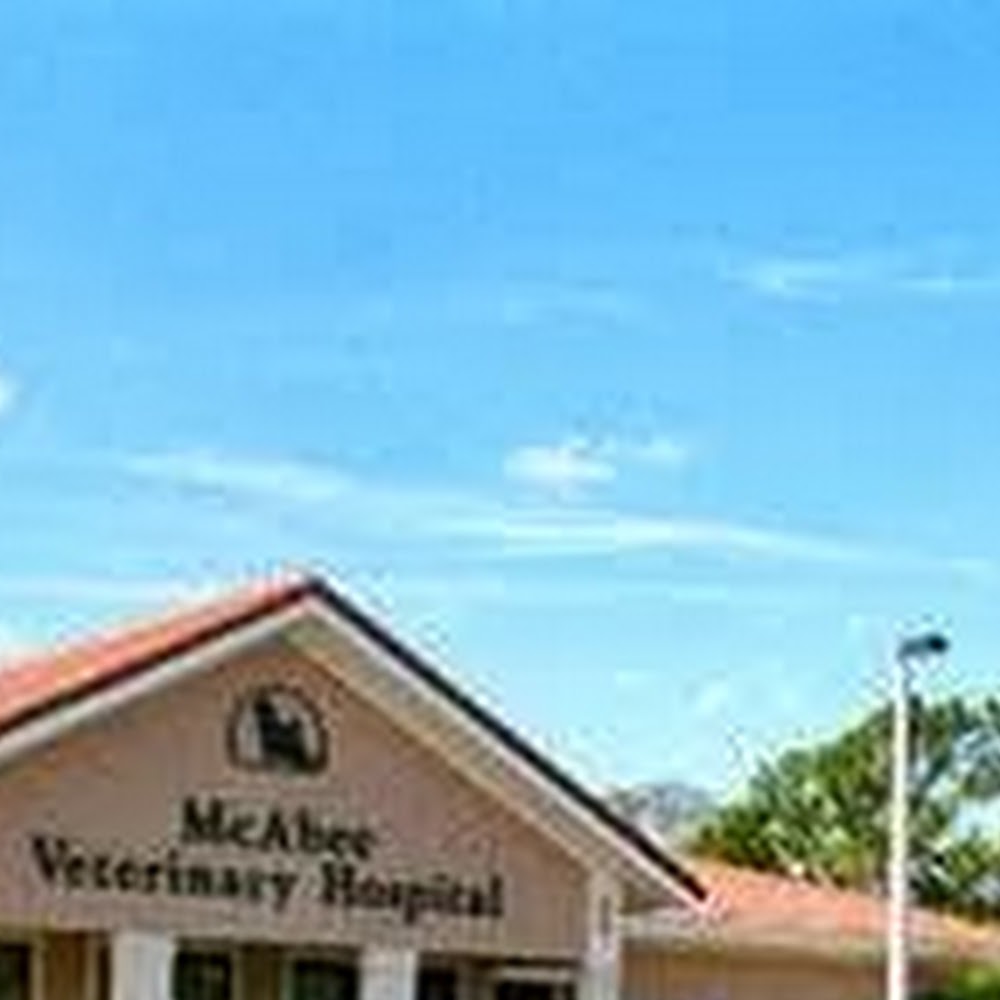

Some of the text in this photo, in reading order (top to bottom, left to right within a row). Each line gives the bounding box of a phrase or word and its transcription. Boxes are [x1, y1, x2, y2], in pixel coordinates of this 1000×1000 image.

[182, 798, 375, 857] McAbee
[32, 838, 504, 922] Veterinary Hospital
